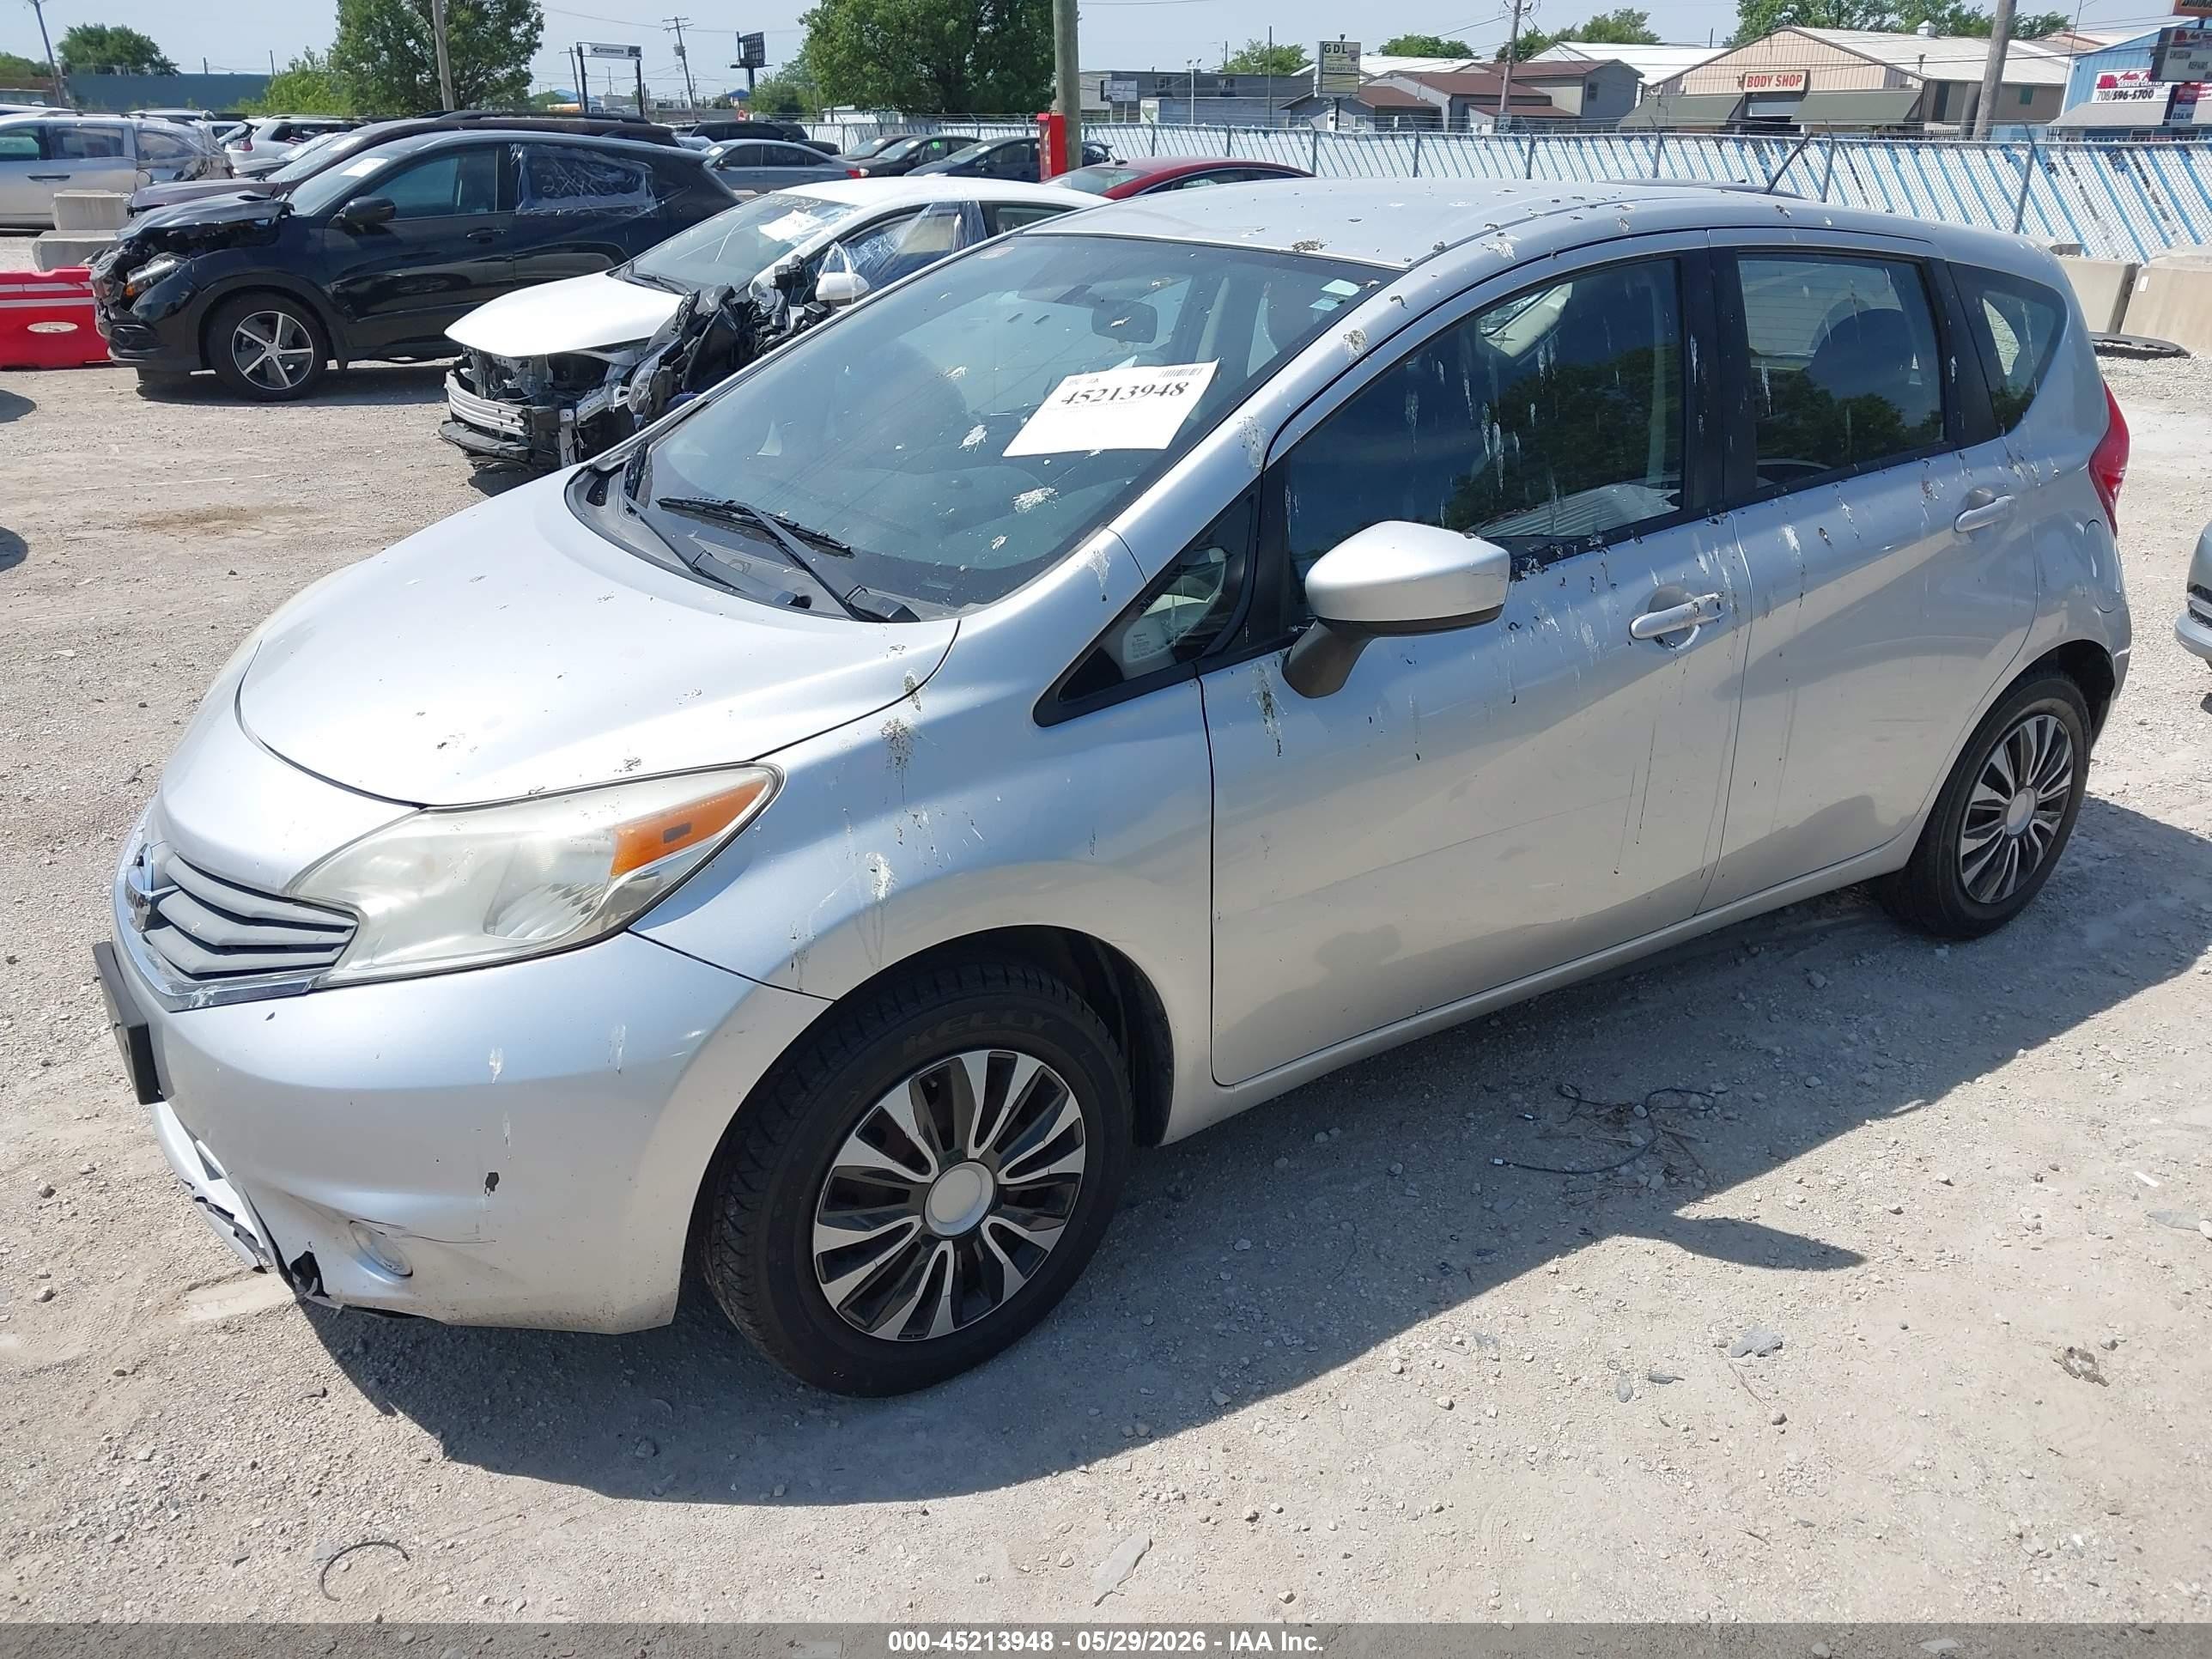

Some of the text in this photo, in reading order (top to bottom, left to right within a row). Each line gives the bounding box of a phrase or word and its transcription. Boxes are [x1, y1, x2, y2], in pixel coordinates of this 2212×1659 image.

[1324, 44, 1347, 54] GDL
[1747, 74, 1802, 88] BODY SHOP
[2097, 88, 2154, 101] 708/596-5700
[1060, 381, 1189, 404] 45213948
[903, 1010, 1054, 1054] KELLY
